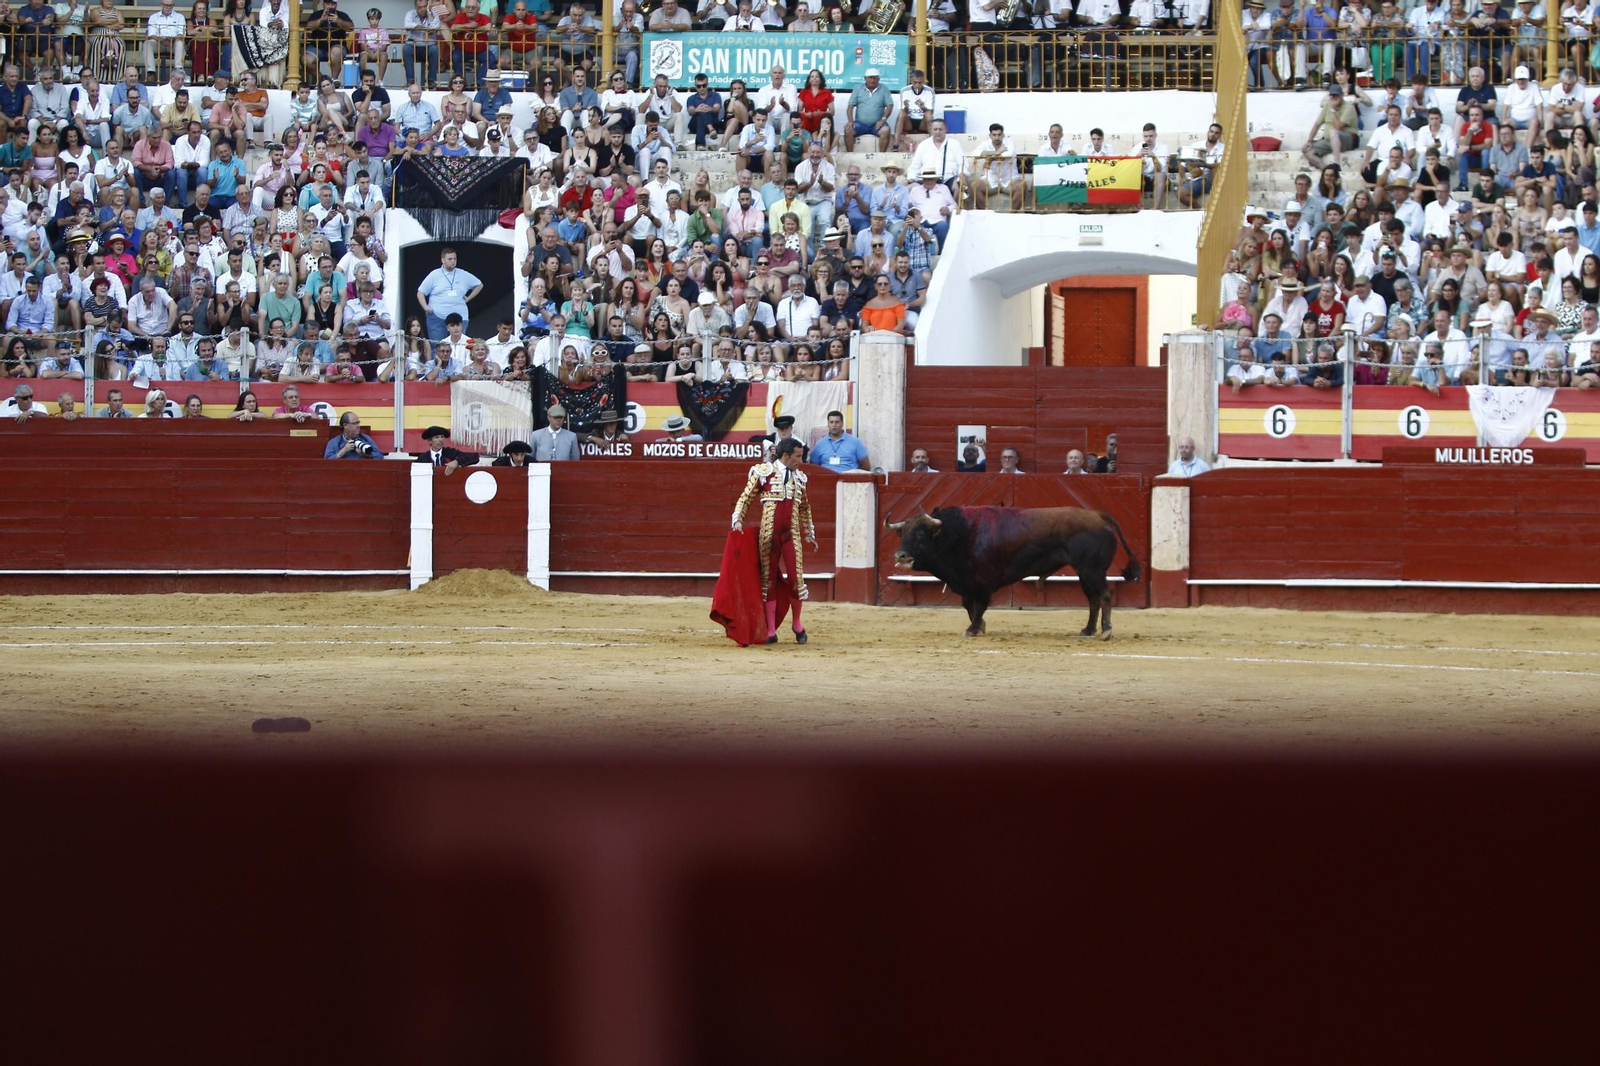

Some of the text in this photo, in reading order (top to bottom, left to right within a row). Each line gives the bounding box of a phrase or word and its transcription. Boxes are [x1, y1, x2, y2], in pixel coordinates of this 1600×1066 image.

[688, 35, 845, 47] AGRUPACIÓN MUSICAL
[688, 48, 845, 75] SAN INDALECIO
[749, 75, 766, 84] San
[1057, 157, 1117, 168] CLARINES
[1059, 176, 1117, 188] TIMBALES
[624, 404, 638, 431] 5
[1272, 407, 1287, 435] 6
[1406, 408, 1422, 437] 6
[1543, 411, 1558, 439] 6
[580, 443, 632, 456] YORALES
[643, 443, 762, 458] MOZOS DE CABALLOS
[1435, 447, 1534, 464] MULILLEROS
